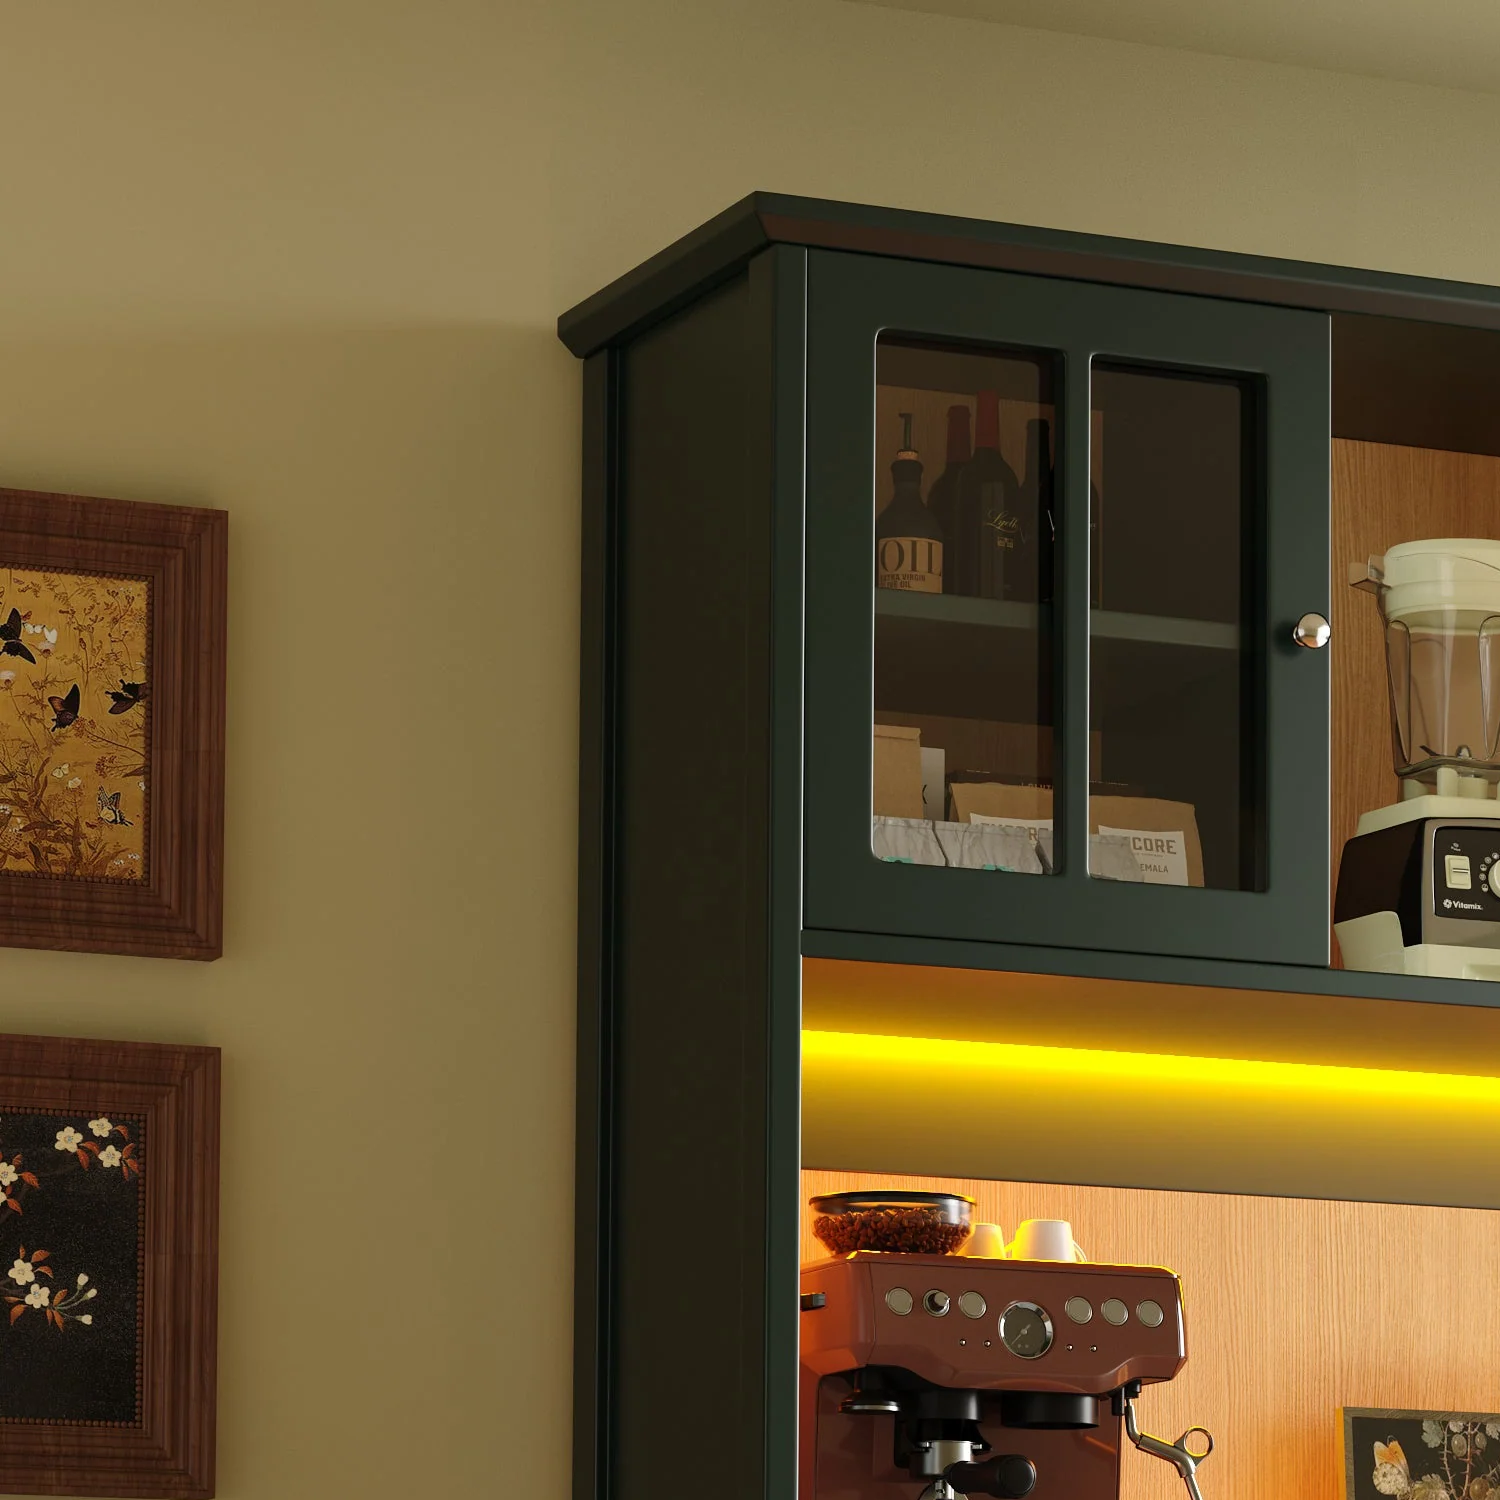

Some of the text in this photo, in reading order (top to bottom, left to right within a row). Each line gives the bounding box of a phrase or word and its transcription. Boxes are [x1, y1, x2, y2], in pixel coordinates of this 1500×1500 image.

[880, 540, 942, 577] OIL
[1132, 837, 1178, 854] CORE
[1453, 901, 1482, 910] Vitamix
